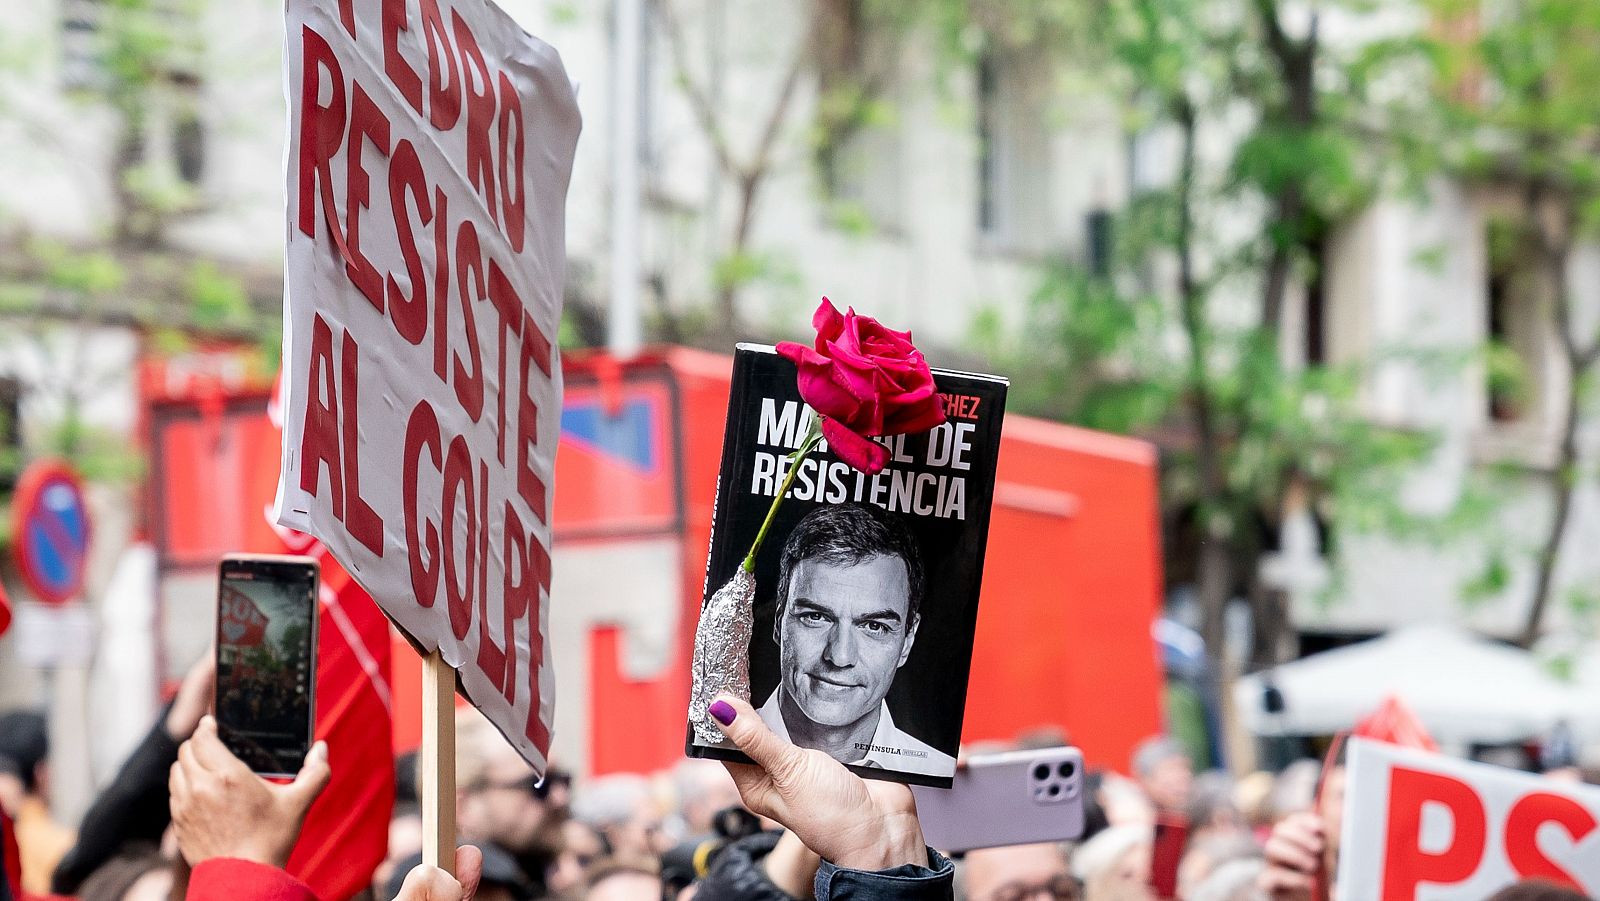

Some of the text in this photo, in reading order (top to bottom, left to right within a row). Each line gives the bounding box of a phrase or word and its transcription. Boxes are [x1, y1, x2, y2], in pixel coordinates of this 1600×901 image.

[337, 0, 525, 254] EDRO
[298, 23, 552, 526] RESISTE
[300, 311, 552, 761] AL GOLPE
[751, 452, 966, 520] RESISTENCIA
[926, 421, 976, 471] DE
